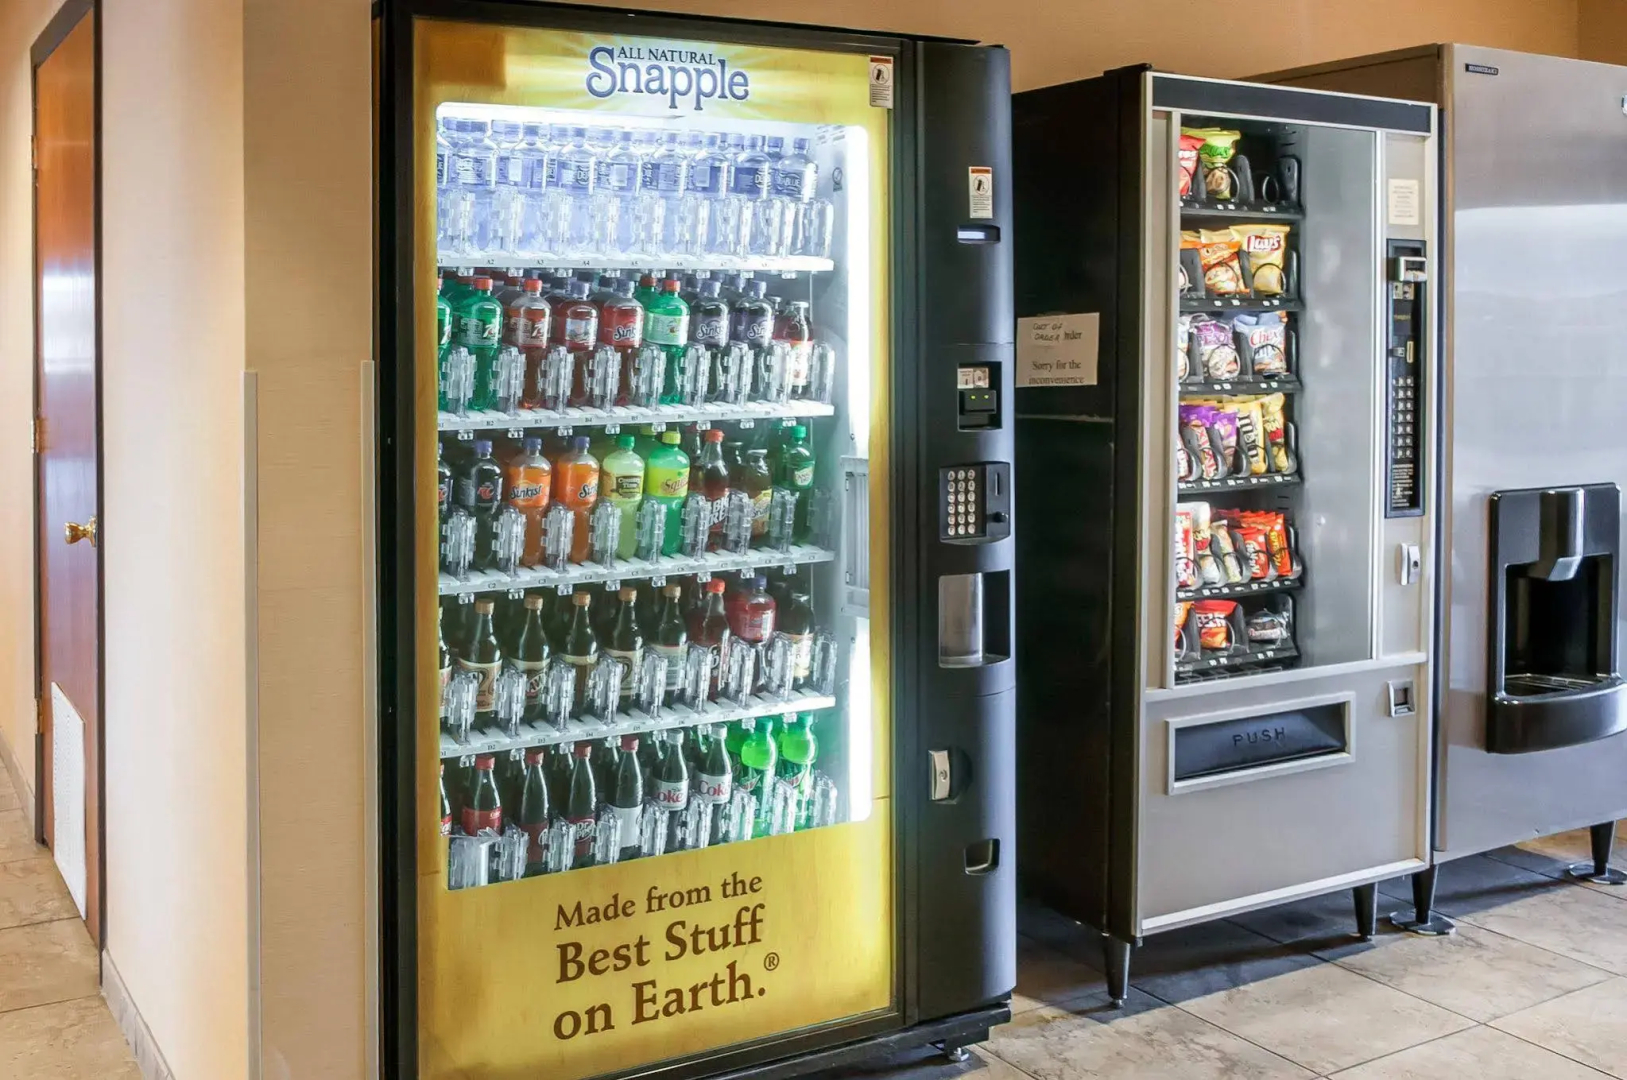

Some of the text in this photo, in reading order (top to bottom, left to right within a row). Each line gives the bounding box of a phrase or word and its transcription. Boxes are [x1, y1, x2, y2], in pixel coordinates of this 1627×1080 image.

[617, 46, 716, 66] ALL NATURAL
[586, 46, 749, 111] Snapple
[1250, 329, 1279, 347] Chex
[1032, 360, 1082, 372] Sorry for the
[510, 484, 543, 500] Sunkist
[1232, 727, 1286, 747] PUSH
[554, 871, 763, 931] Made from the
[556, 902, 766, 984] Best Stuff
[553, 1002, 615, 1040] on
